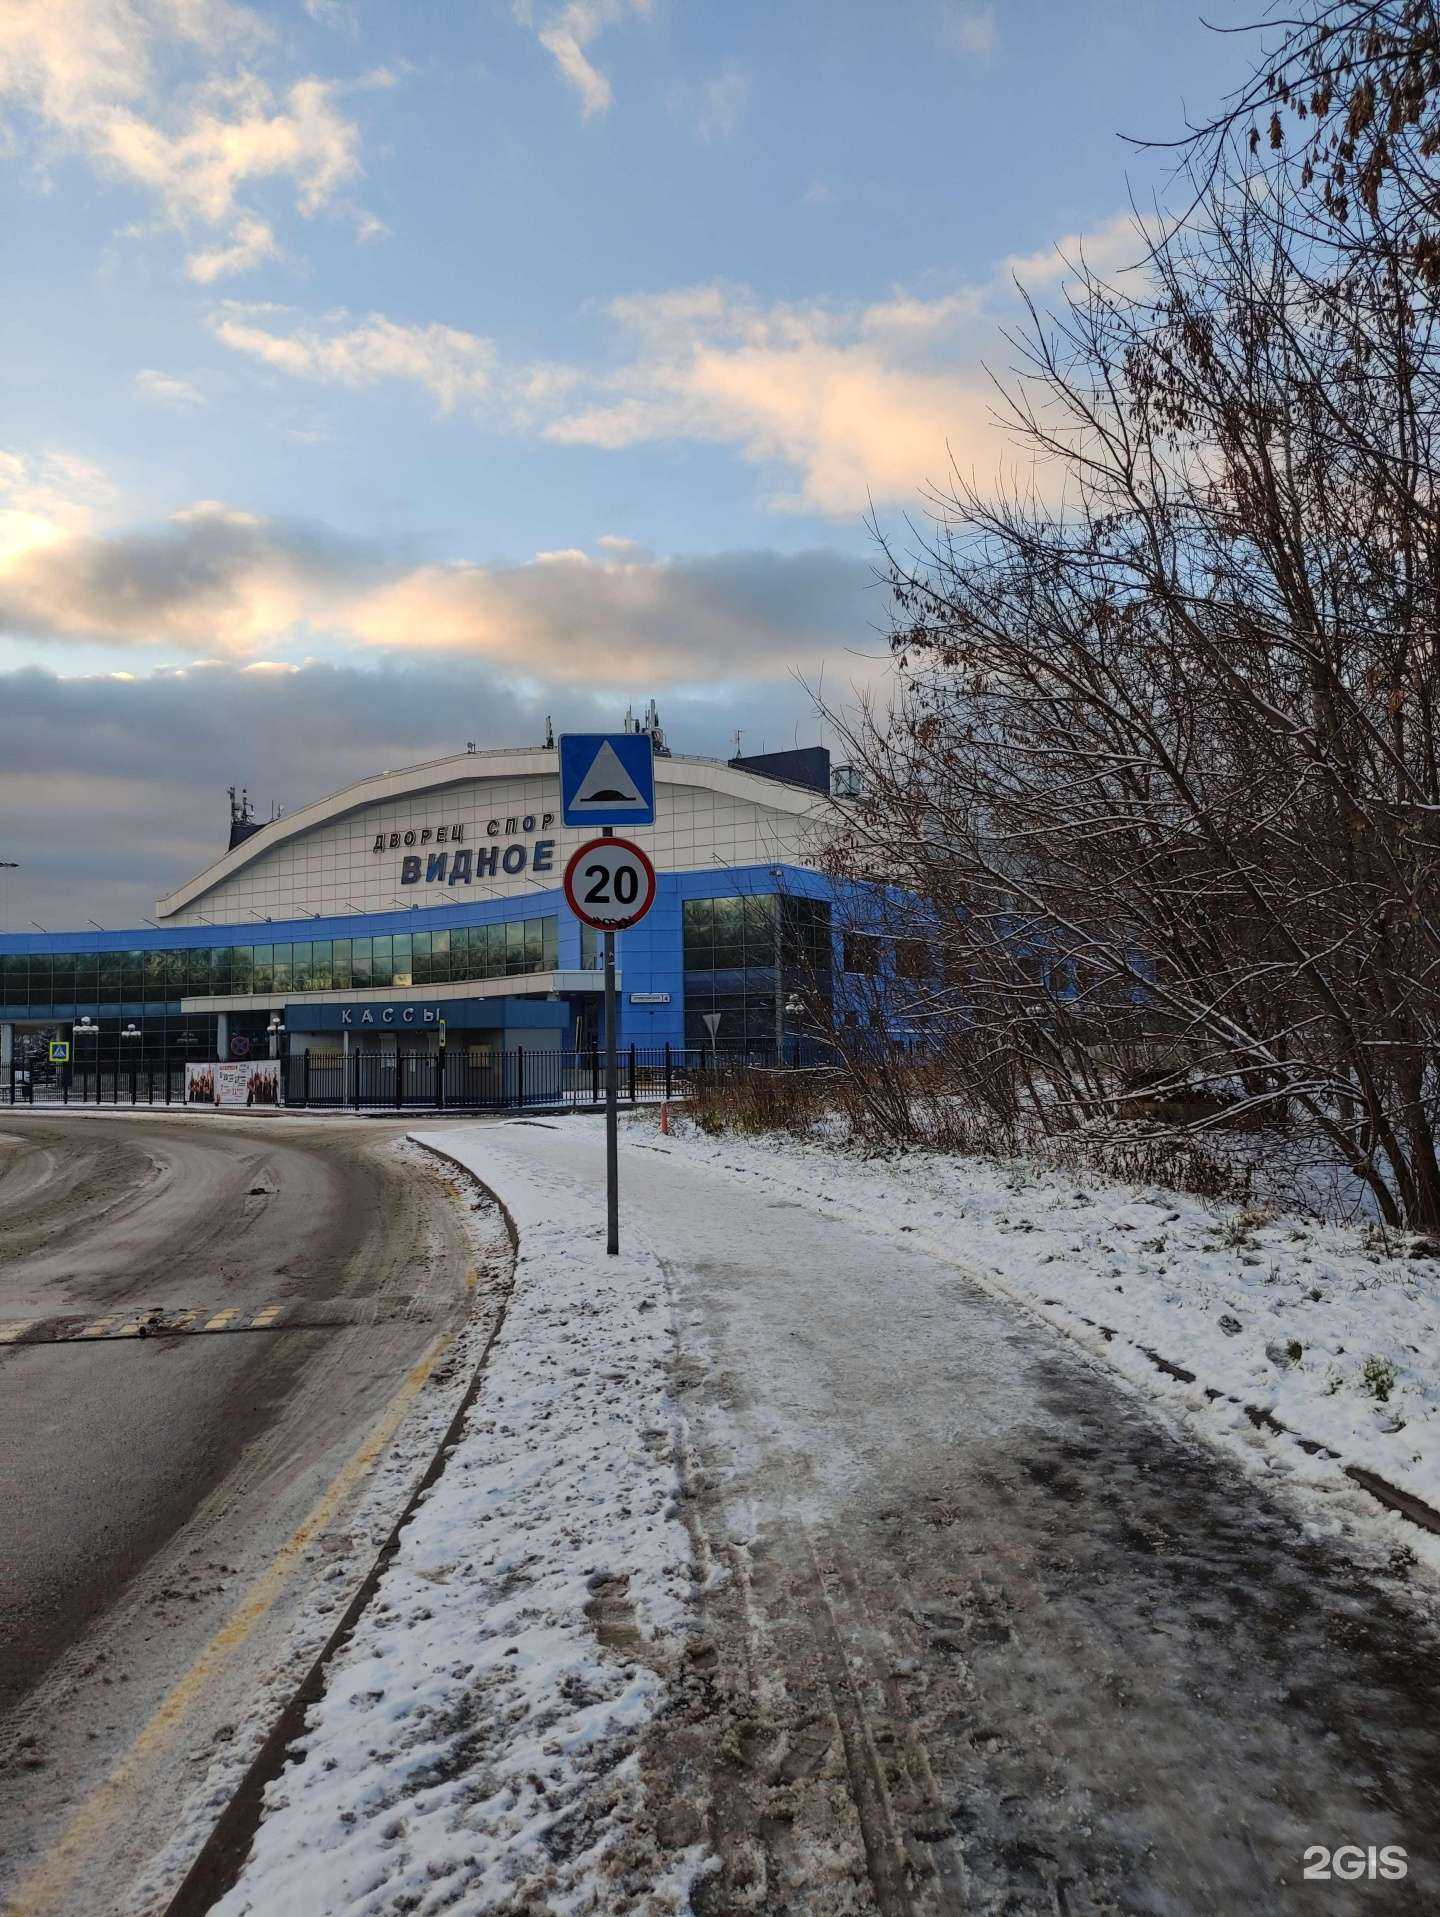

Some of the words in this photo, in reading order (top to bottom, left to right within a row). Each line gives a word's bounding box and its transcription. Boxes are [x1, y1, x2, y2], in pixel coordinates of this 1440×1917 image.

[373, 823, 464, 854] ДВОРЕЦ
[486, 813, 555, 838] СПОР
[401, 839, 556, 886] ВИДНОЕ
[584, 864, 639, 905] 20
[341, 1008, 441, 1024] КАССЫ
